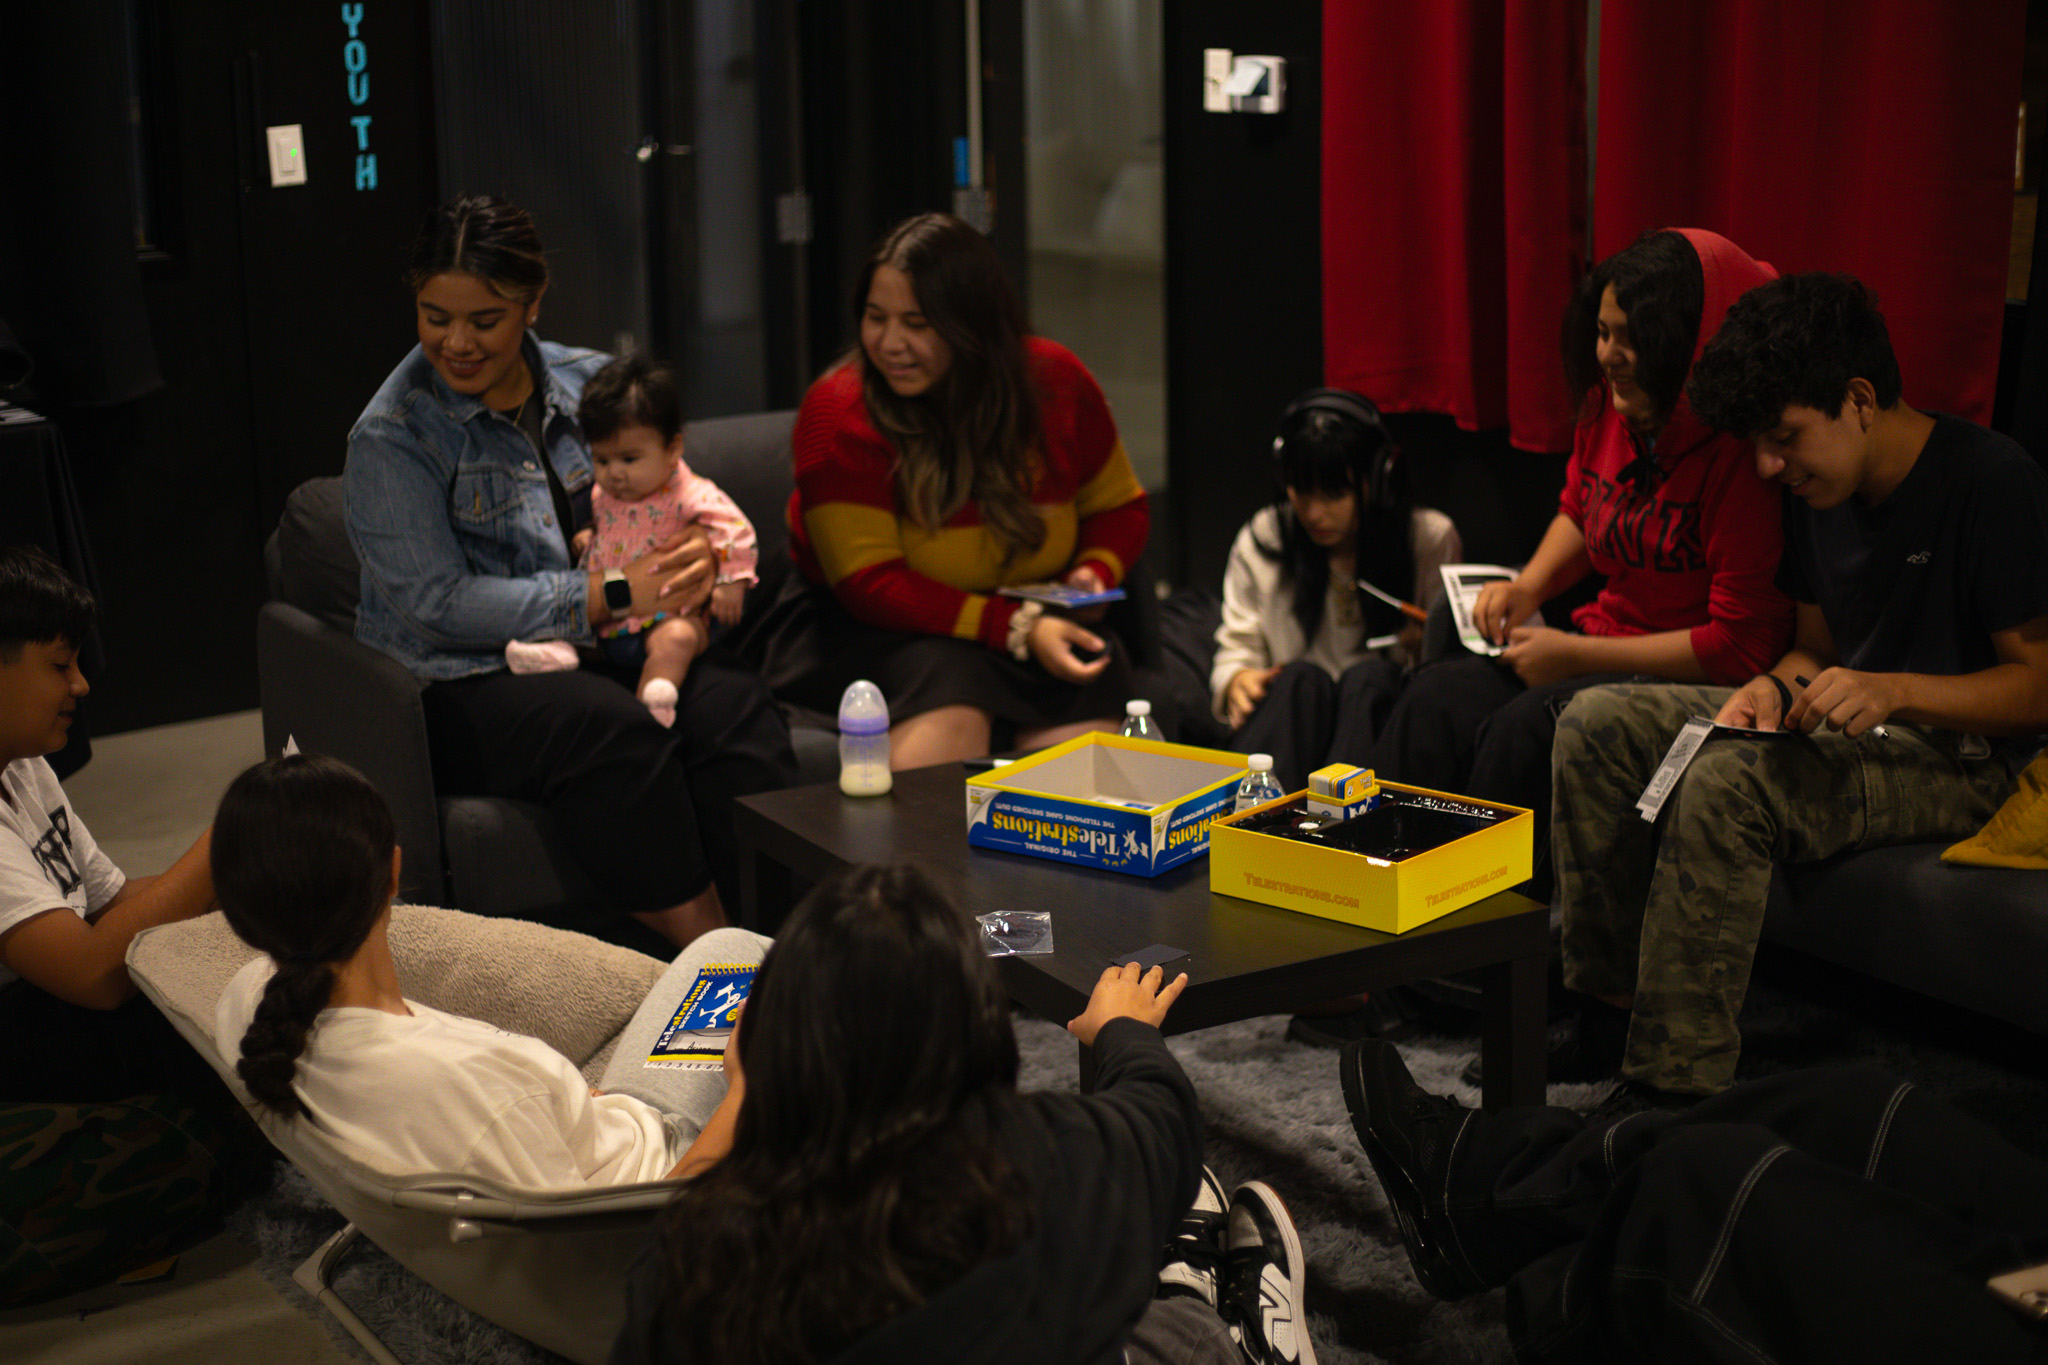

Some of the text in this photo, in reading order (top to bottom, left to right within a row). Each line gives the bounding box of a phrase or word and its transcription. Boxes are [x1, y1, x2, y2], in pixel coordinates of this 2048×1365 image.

[340, 1, 379, 192] YOUTH
[1011, 805, 1045, 817] SKETCHED
[1044, 810, 1064, 819] GAME
[1064, 813, 1101, 826] TELEPHONE
[1102, 819, 1116, 829] THE
[991, 811, 1120, 857] Telestrations
[1023, 842, 1078, 858] THE ORIGINAL
[657, 979, 708, 1050] Telestrations
